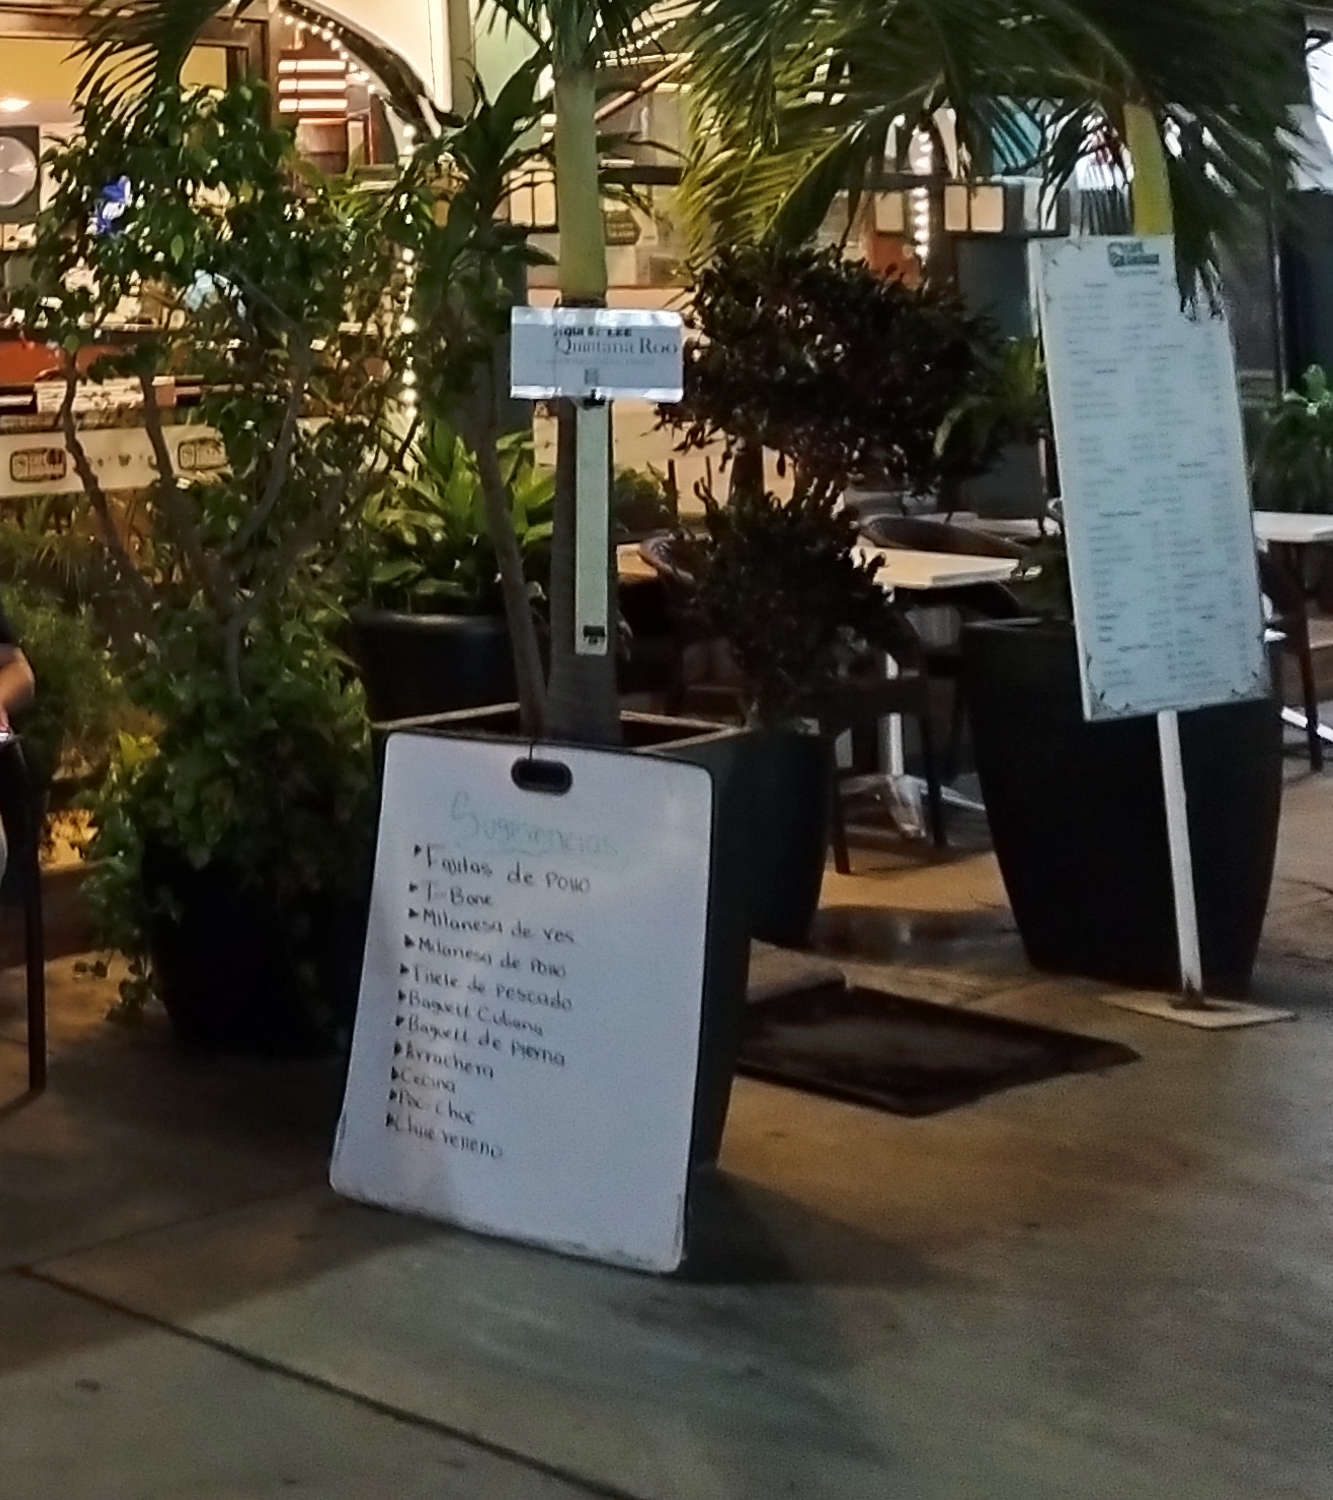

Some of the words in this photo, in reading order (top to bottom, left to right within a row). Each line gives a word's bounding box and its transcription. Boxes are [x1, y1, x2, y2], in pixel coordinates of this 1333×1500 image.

[555, 337, 634, 355] Quintana
[507, 861, 534, 885] de
[422, 908, 503, 933] Milanesa
[511, 920, 532, 939] de
[418, 936, 492, 965] Milanesa
[500, 951, 520, 969] de
[467, 974, 486, 993] de
[478, 1028, 502, 1051] de
